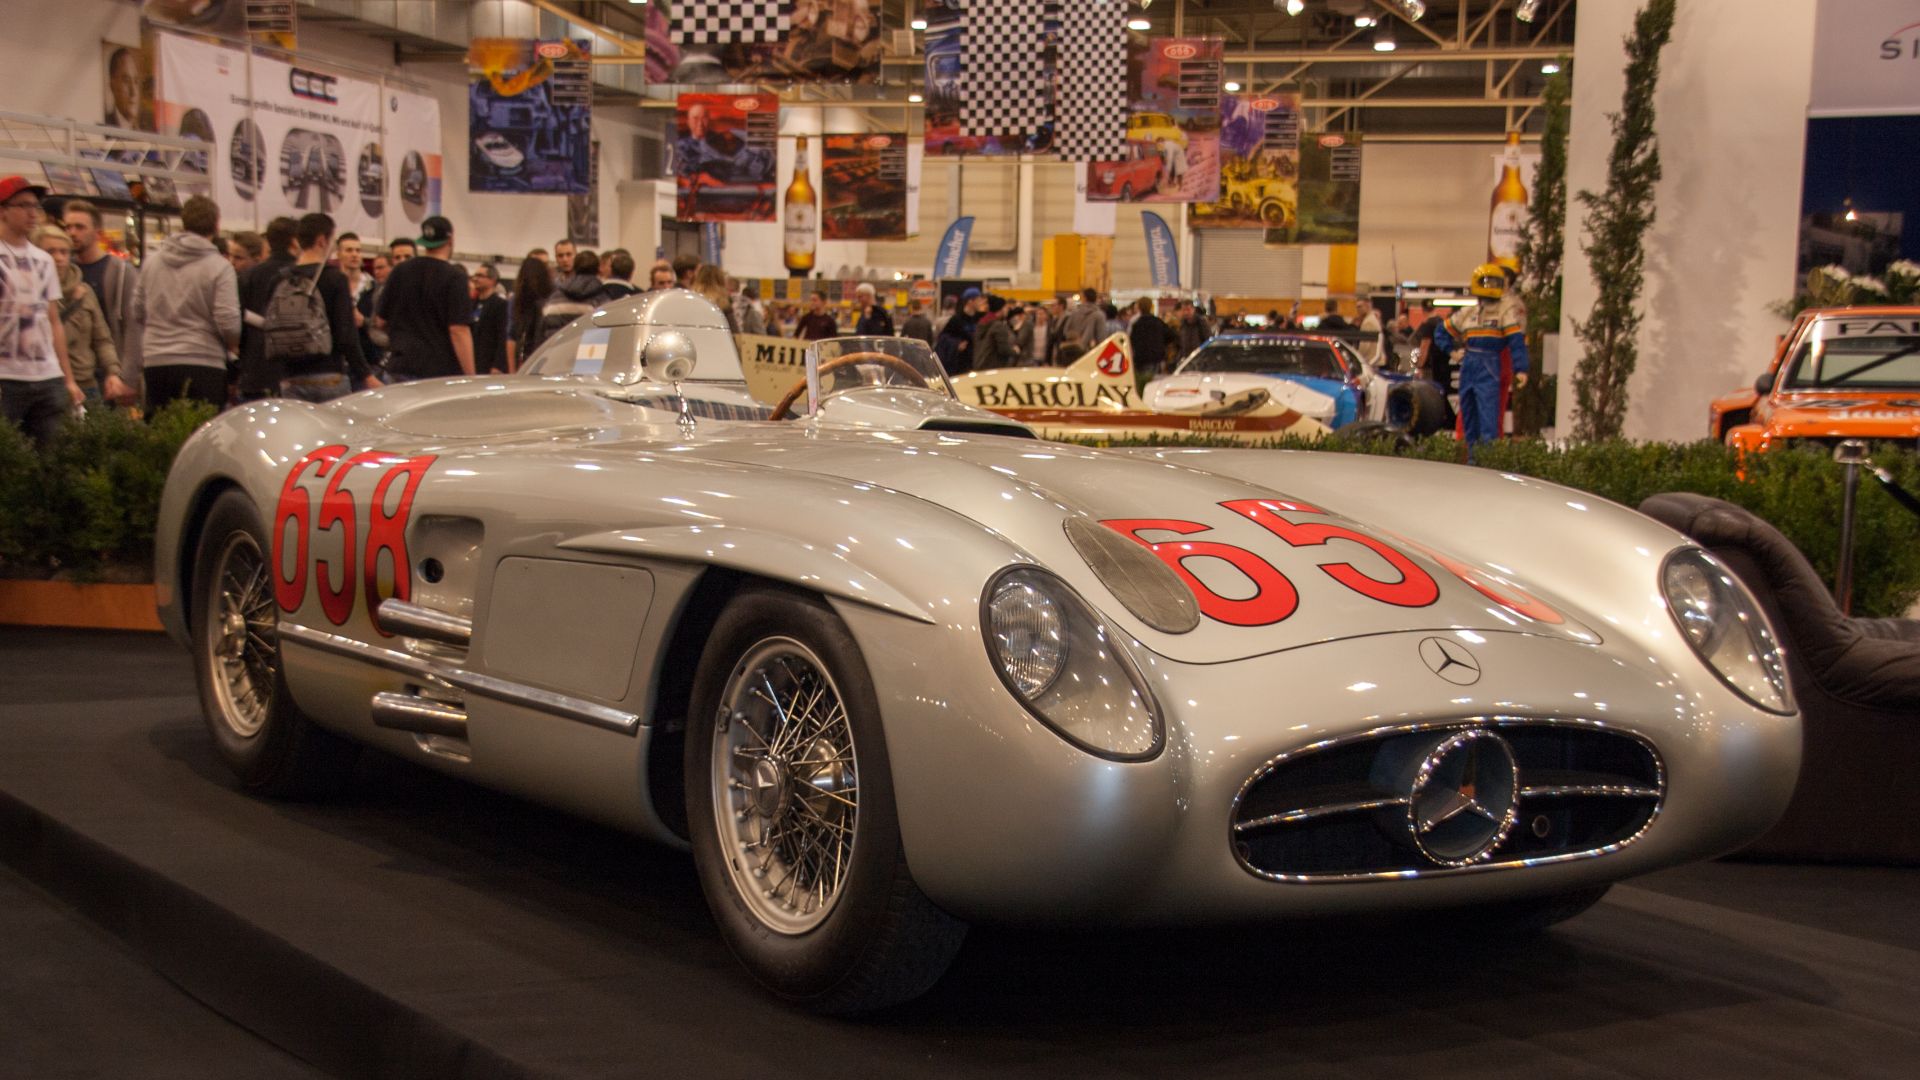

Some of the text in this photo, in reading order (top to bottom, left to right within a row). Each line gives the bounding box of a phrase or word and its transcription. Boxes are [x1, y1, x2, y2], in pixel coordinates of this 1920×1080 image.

[974, 382, 1132, 408] BARCLAY
[1189, 419, 1236, 430] BARCLAY
[273, 444, 438, 638] 658
